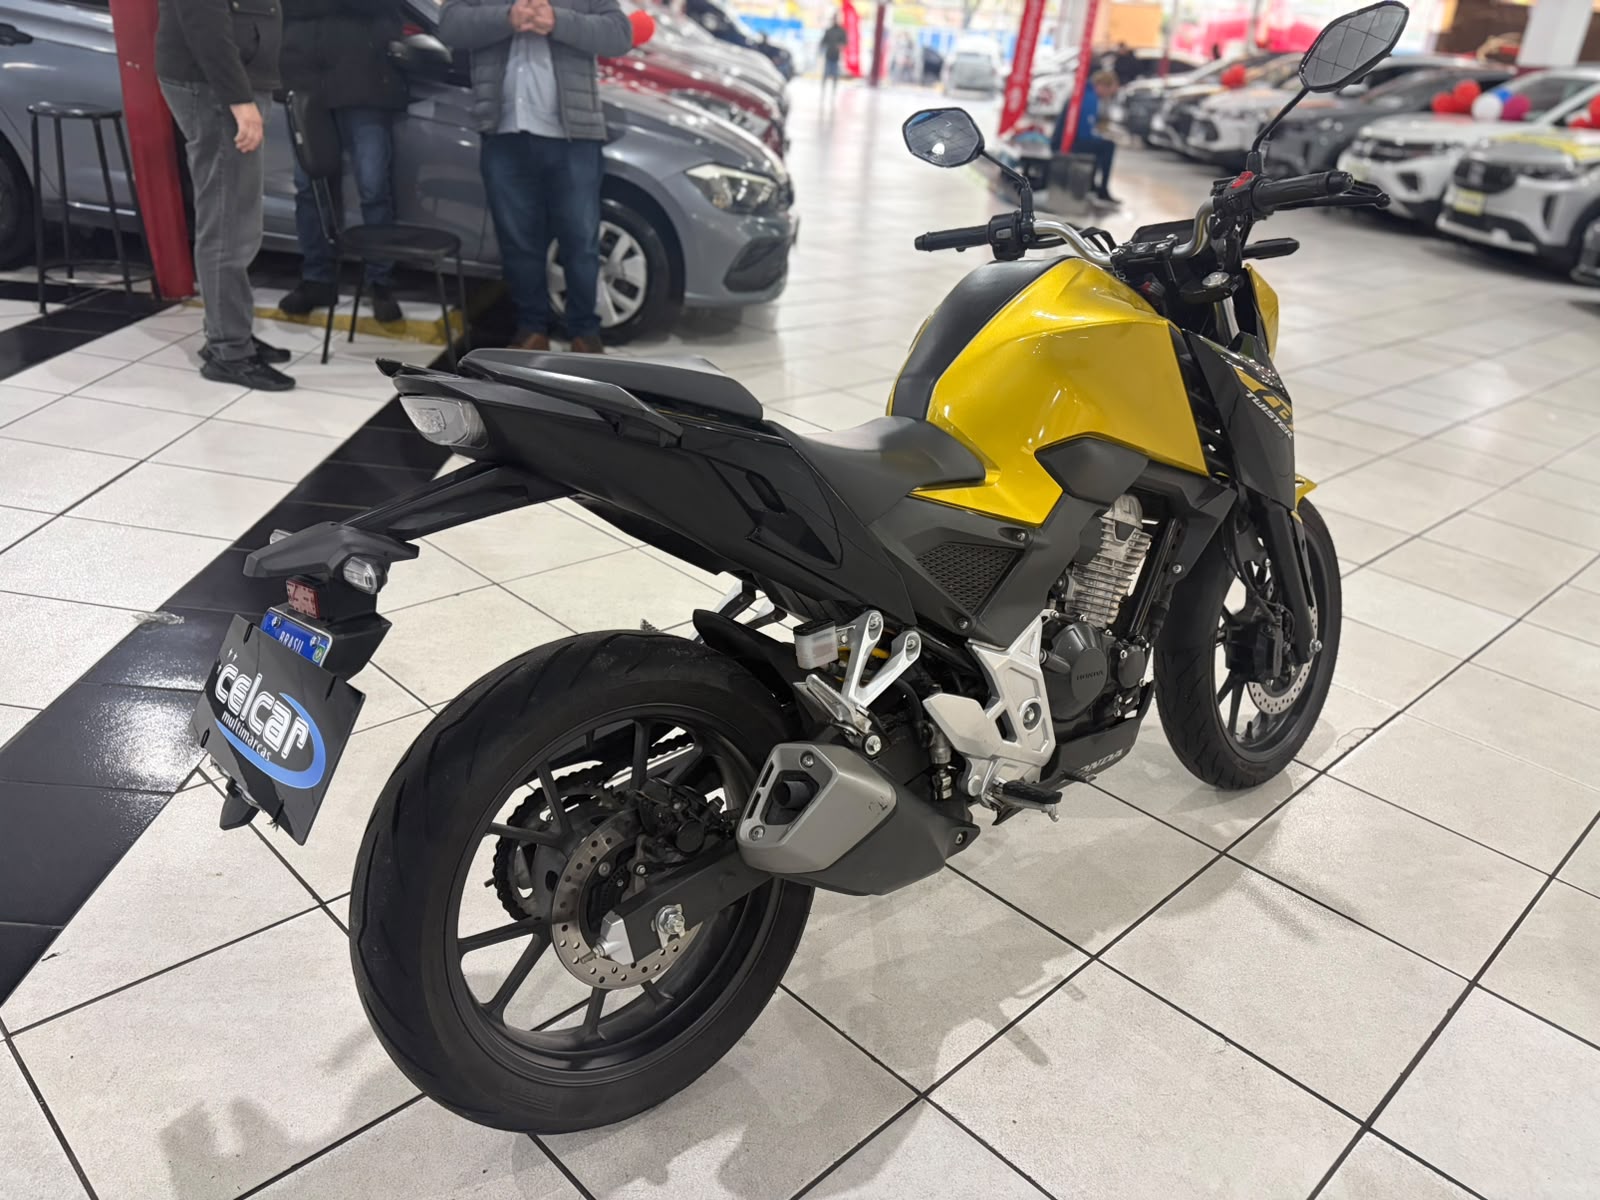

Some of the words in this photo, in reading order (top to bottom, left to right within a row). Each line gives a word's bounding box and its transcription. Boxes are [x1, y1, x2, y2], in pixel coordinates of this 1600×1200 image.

[1245, 389, 1293, 440] TWISTER
[278, 631, 304, 654] BRASIL
[221, 710, 272, 762] multimarcas
